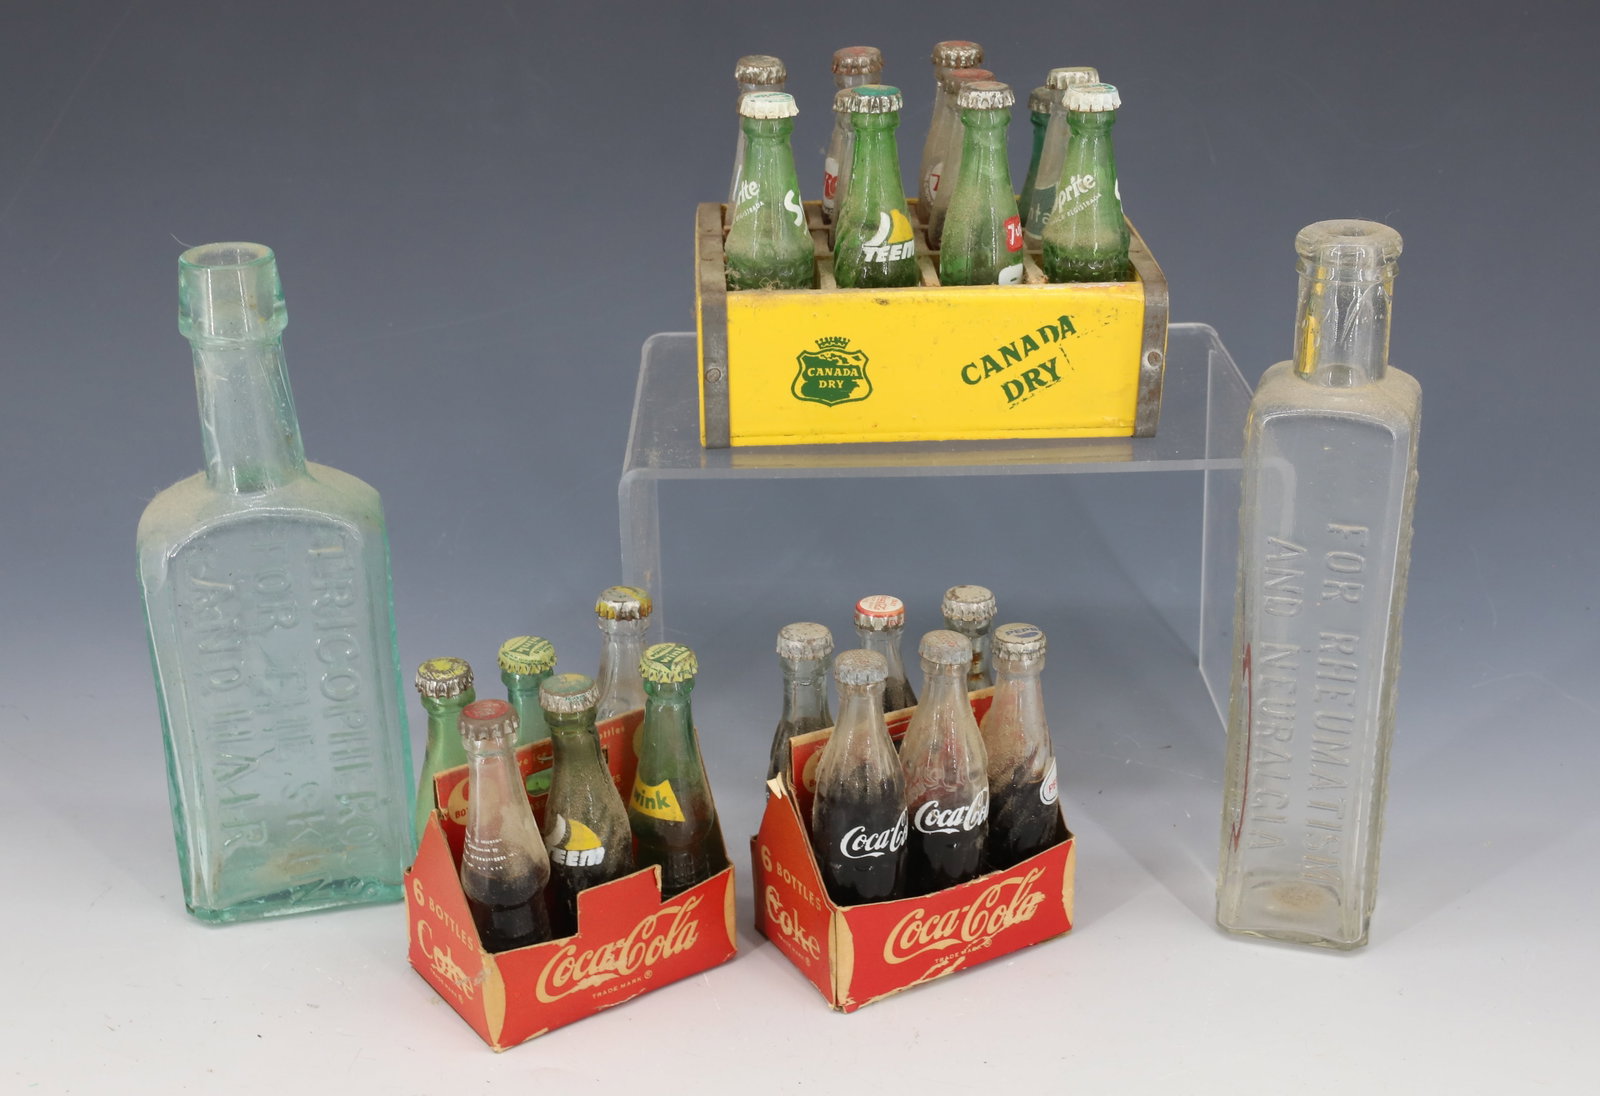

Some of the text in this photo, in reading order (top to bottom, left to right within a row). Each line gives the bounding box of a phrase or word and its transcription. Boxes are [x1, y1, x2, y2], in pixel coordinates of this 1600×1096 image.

[1057, 174, 1096, 213] prite
[807, 367, 859, 377] CANADA
[961, 315, 1077, 385] CANADA
[818, 380, 844, 389] DRY
[1000, 357, 1061, 403] DRY
[1248, 536, 1308, 851] AND NEURALGIA
[1302, 523, 1370, 888] FOR RHEUMATISM
[761, 845, 773, 873] 6
[413, 878, 425, 906] 6
[776, 862, 821, 911] BOTTLES
[429, 896, 474, 952] BOTTLES
[765, 885, 821, 961] Coke
[592, 977, 642, 999] TRADE MARK
